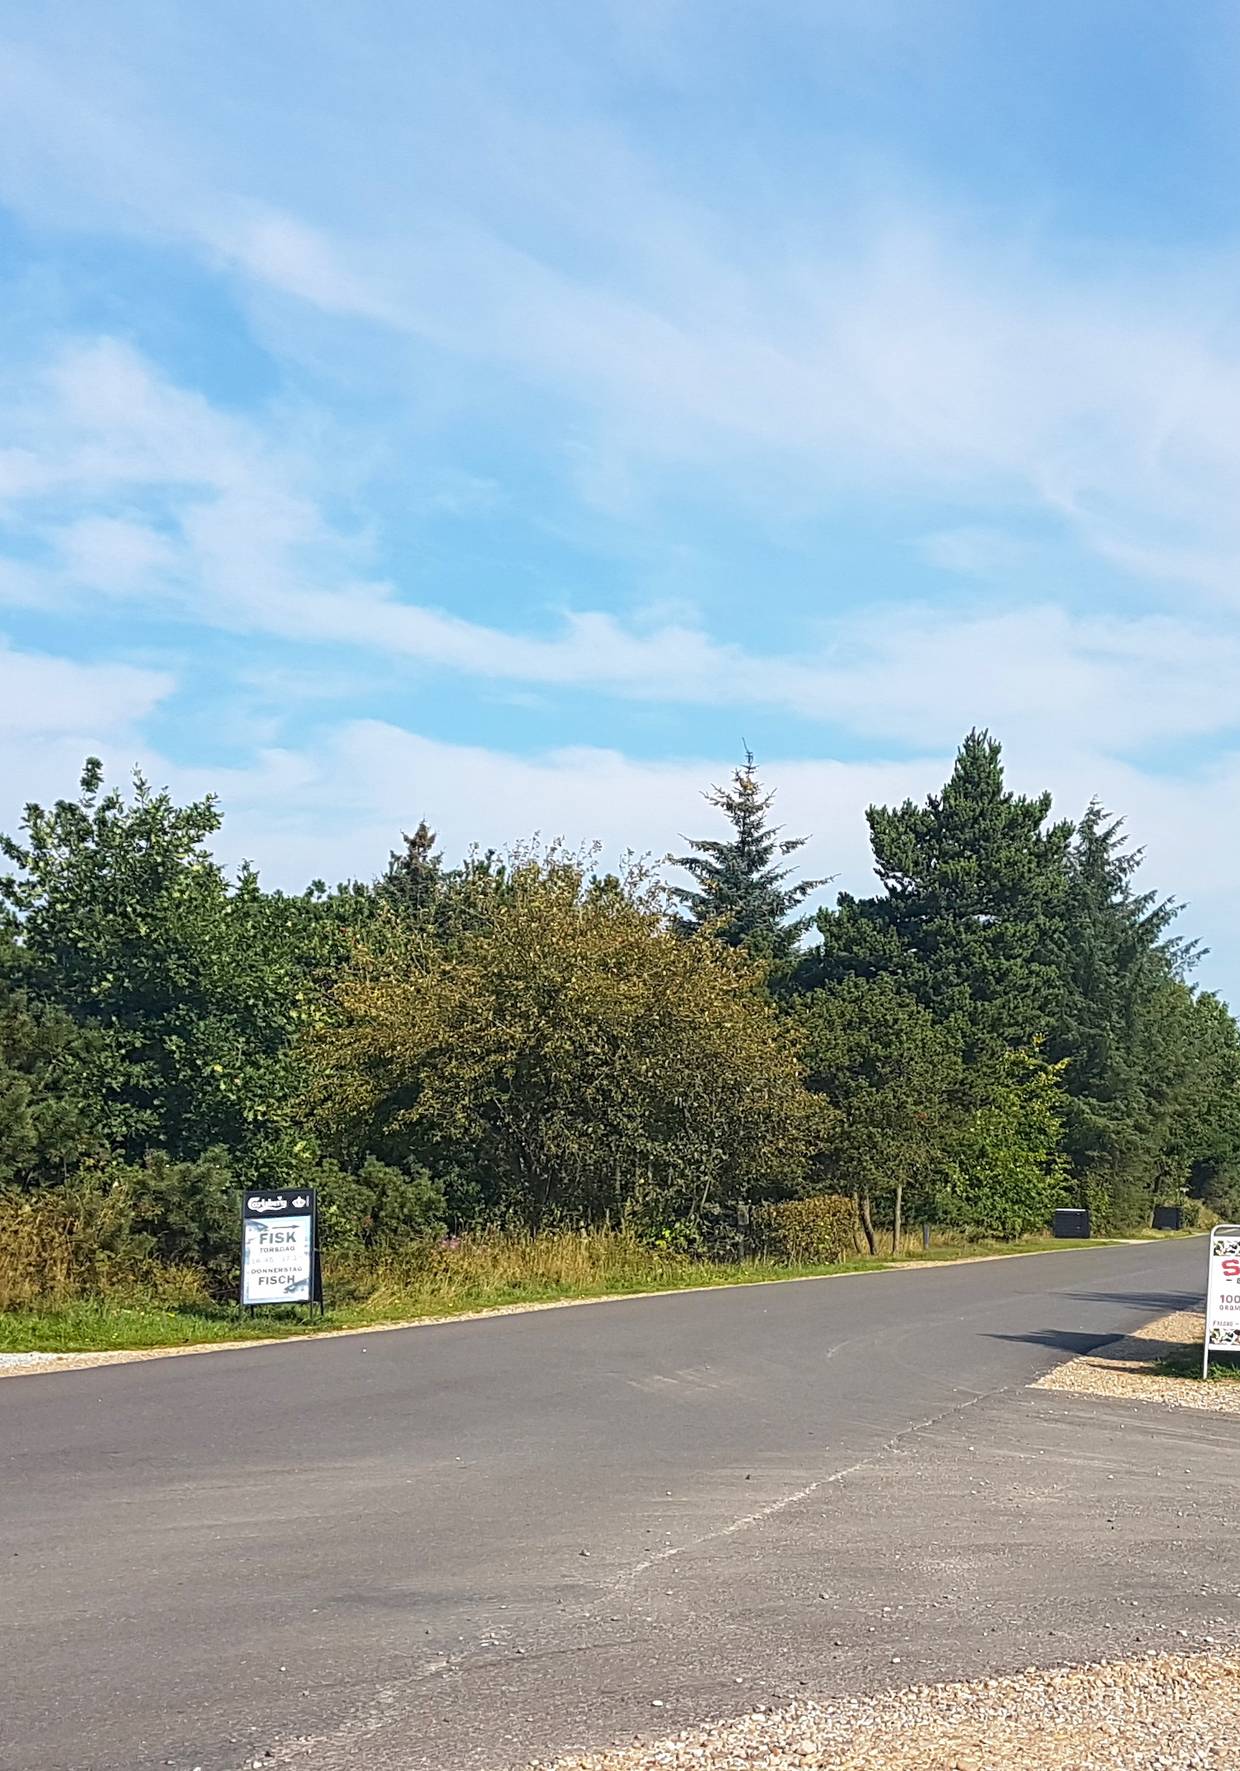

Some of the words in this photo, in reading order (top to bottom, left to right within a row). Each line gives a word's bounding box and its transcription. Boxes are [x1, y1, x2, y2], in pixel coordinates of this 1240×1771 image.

[260, 1232, 297, 1245] FISK
[258, 1275, 296, 1286] FISCH
[1219, 1294, 1240, 1304] 100
